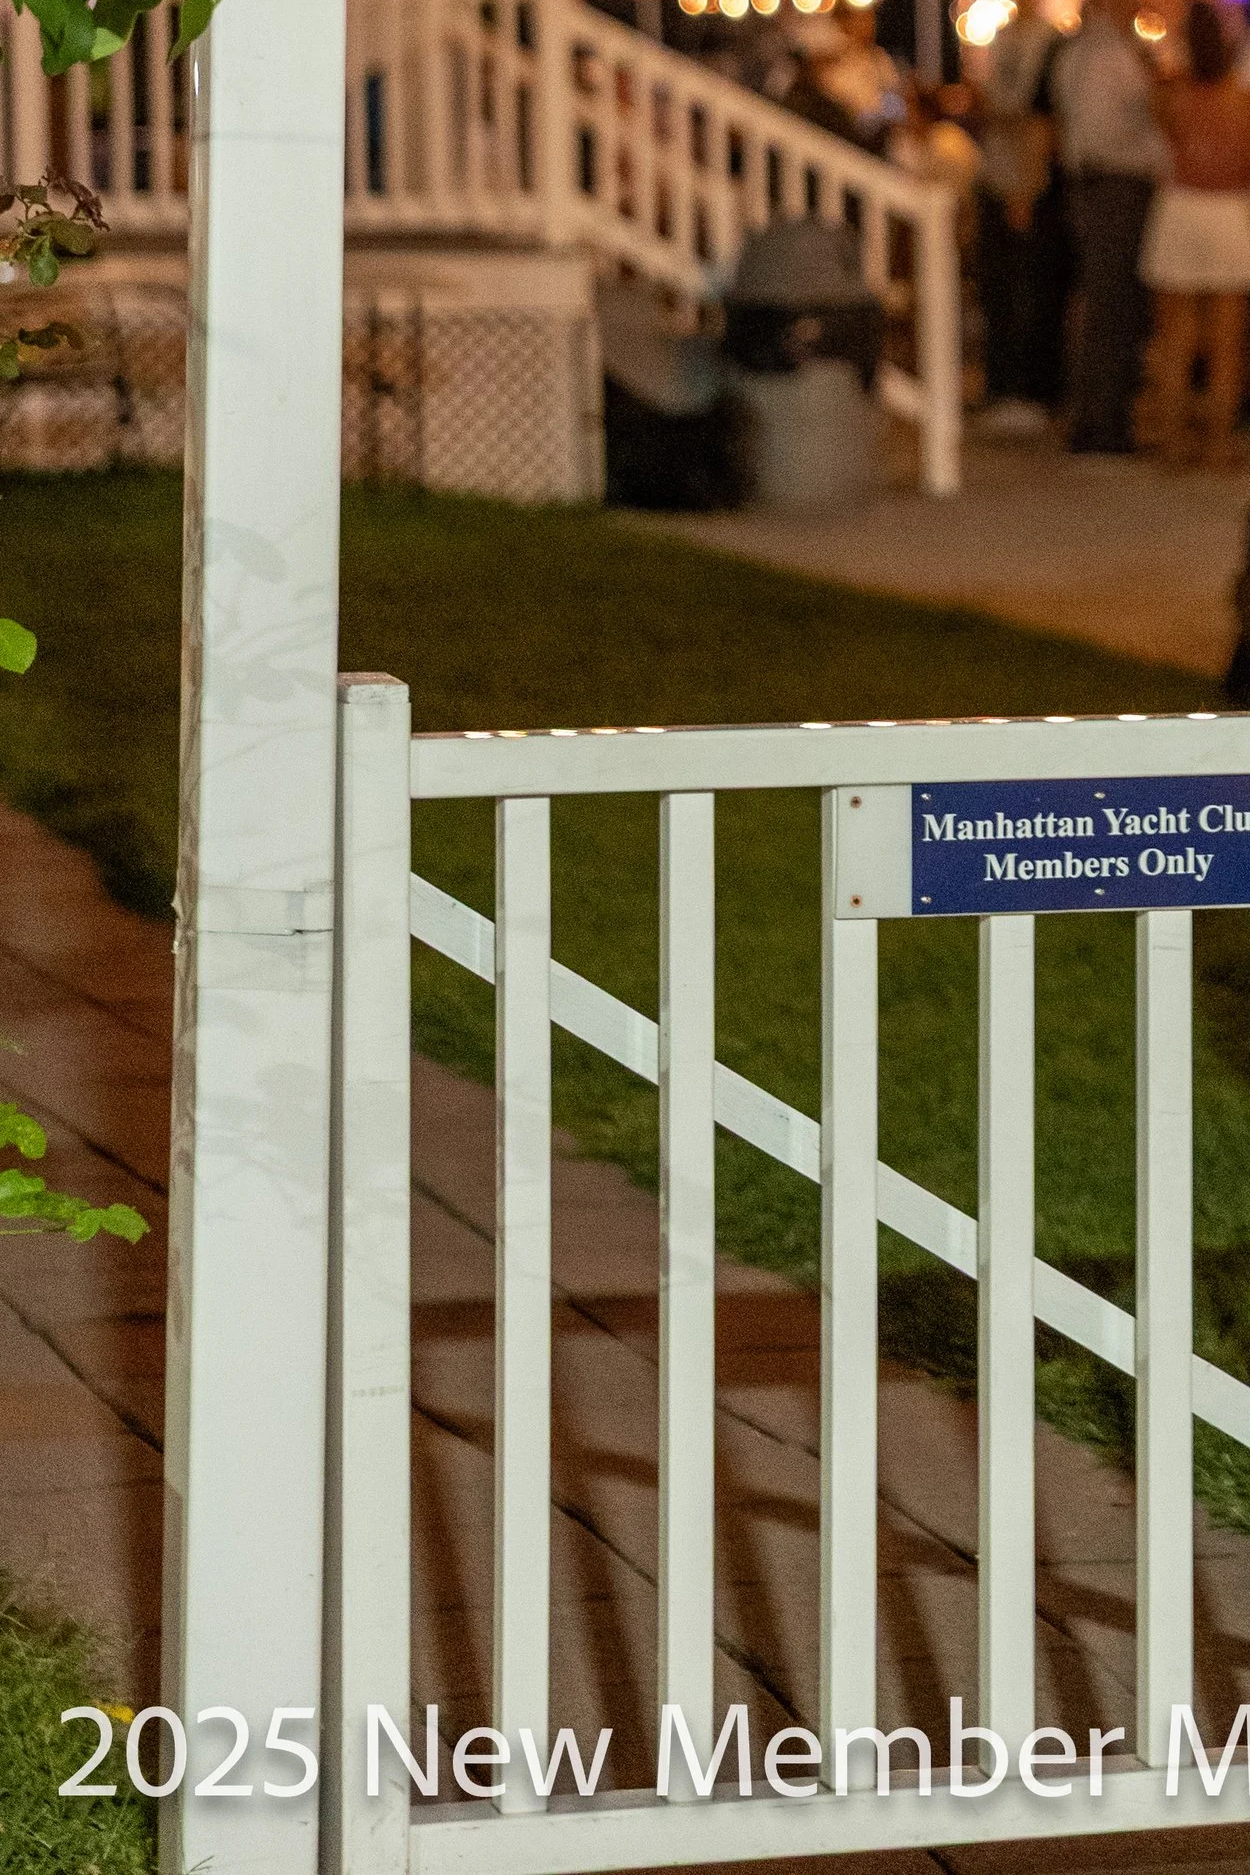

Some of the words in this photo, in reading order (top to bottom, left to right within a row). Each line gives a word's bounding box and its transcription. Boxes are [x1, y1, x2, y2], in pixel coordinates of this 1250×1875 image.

[922, 811, 1094, 843] Manhattan
[1102, 806, 1191, 836] Yacht
[984, 851, 1130, 882] Members
[1138, 847, 1214, 882] Only
